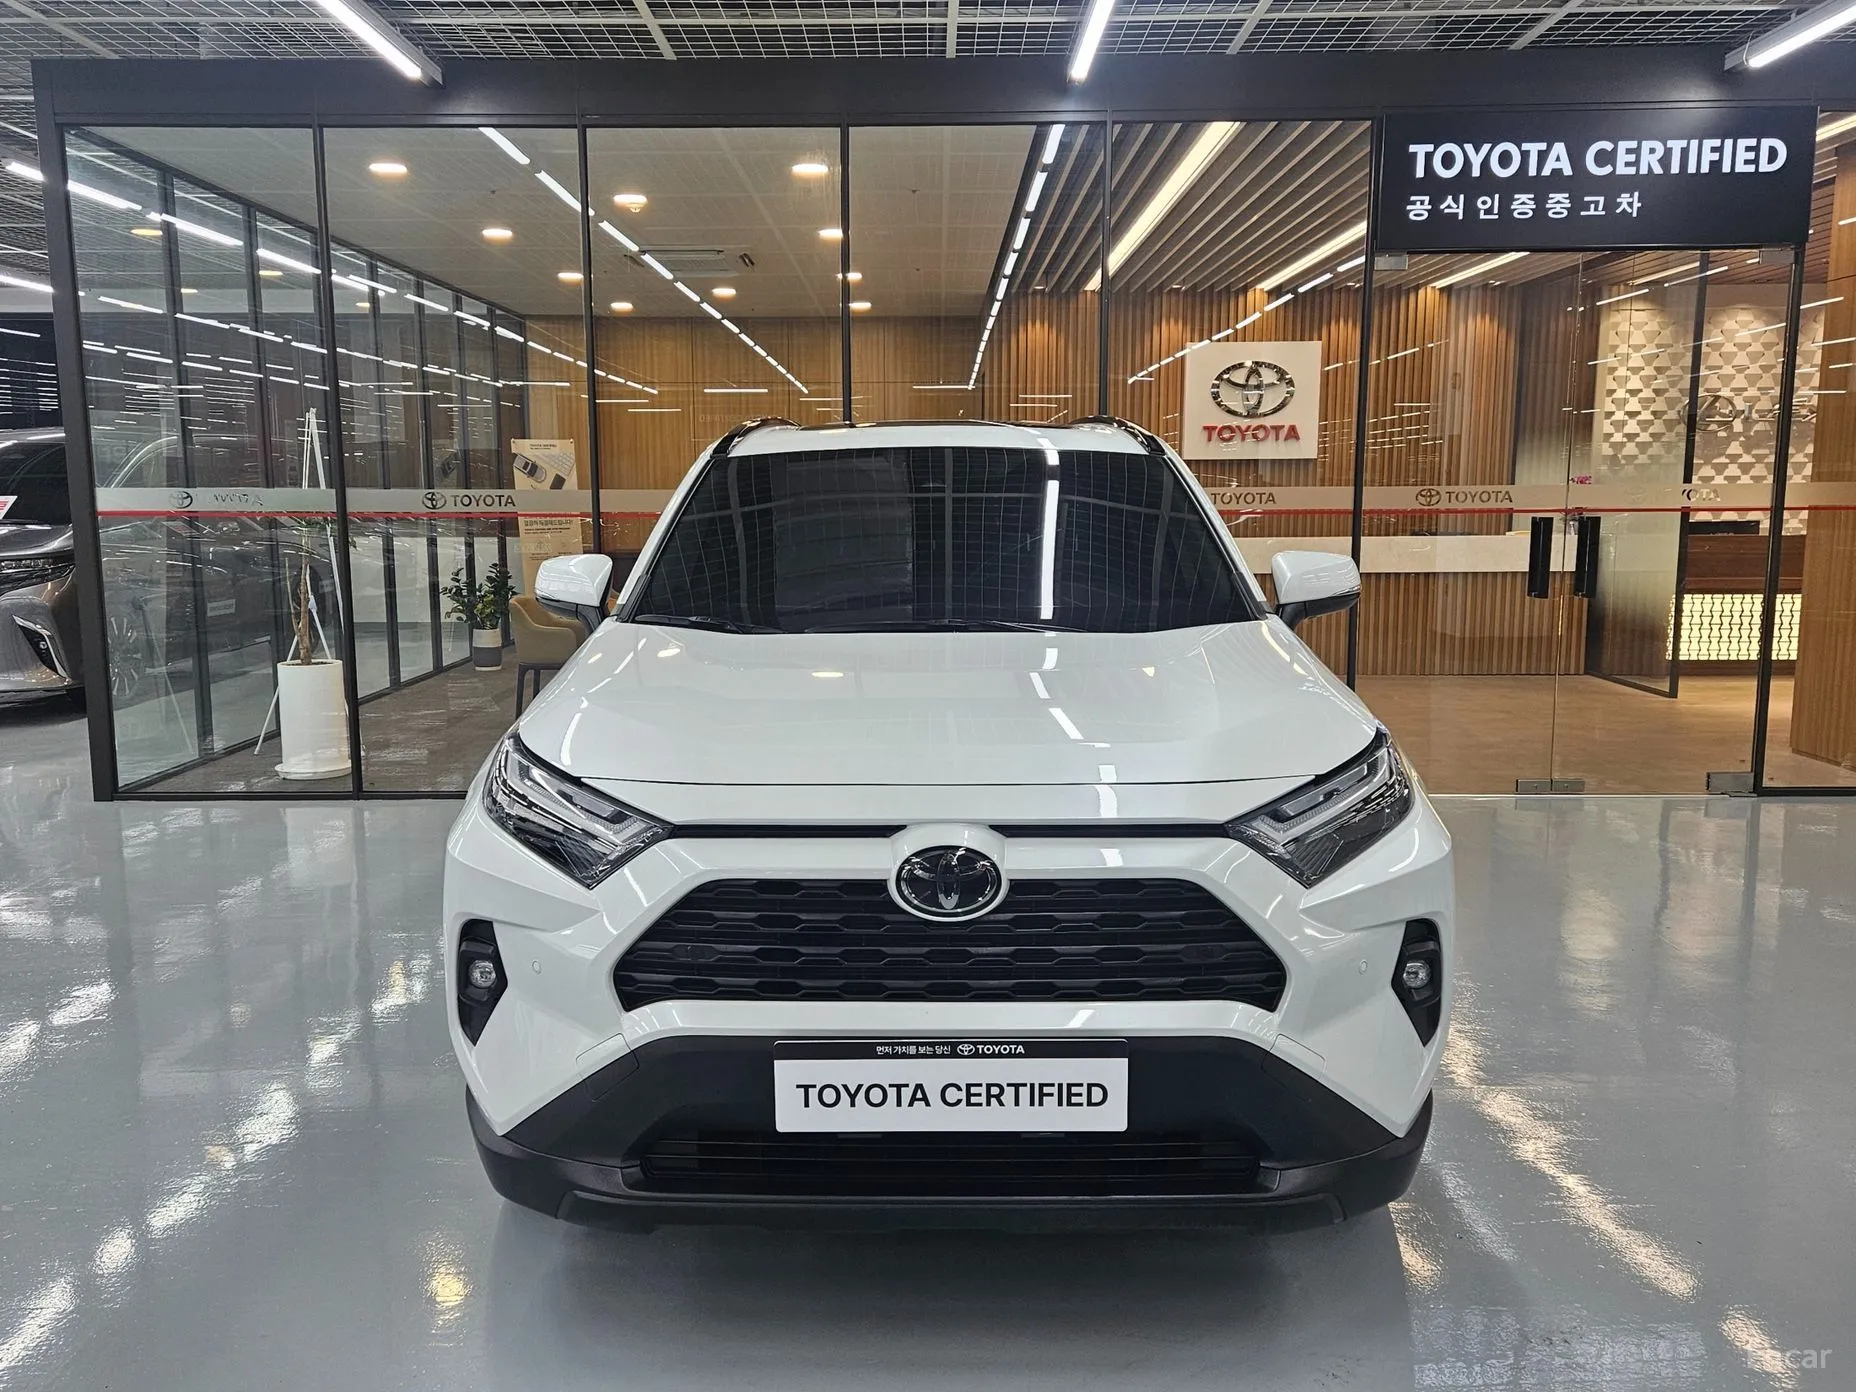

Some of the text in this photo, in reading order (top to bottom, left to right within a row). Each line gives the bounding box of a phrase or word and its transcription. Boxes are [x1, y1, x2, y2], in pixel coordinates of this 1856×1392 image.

[1408, 137, 1788, 178] TOYOTA CERTIFIED
[1405, 191, 1643, 221] 공식인증중고차
[1202, 424, 1301, 442] TOYOTA
[450, 494, 517, 507] TOYOTA
[1210, 491, 1277, 506] TOYOTA
[1445, 490, 1513, 504] TOYOTA
[876, 1044, 951, 1055] 먼저 가치를 보는 당신
[976, 1044, 1026, 1054] TOYOTA
[795, 1081, 1109, 1109] TOYOTA CERTIFIED
